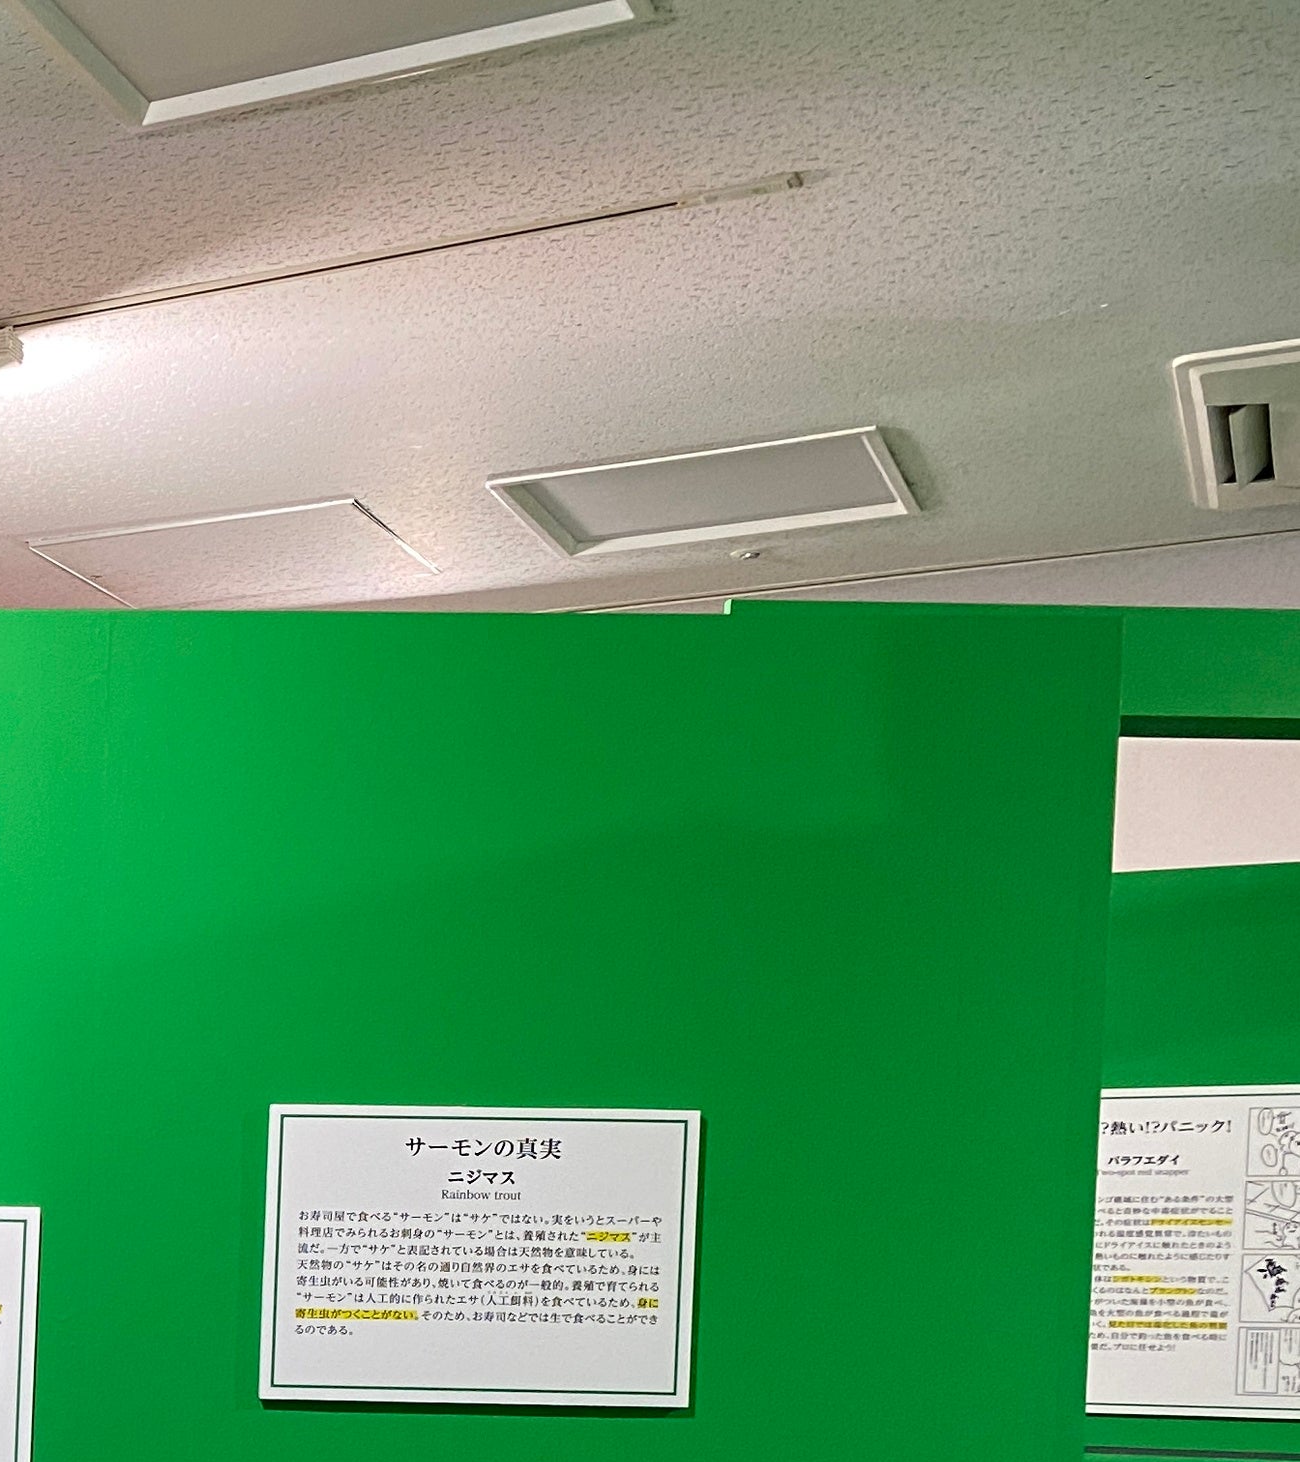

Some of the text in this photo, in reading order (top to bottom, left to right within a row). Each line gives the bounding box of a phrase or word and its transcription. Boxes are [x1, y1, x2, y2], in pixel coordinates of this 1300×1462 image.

[405, 1136, 563, 1160] サーモンの真実
[1107, 1154, 1180, 1166] バラフエダイ
[447, 1168, 516, 1185] ニジマス
[440, 1189, 522, 1201] Rainbow trout
[294, 1324, 354, 1336] るのである。
